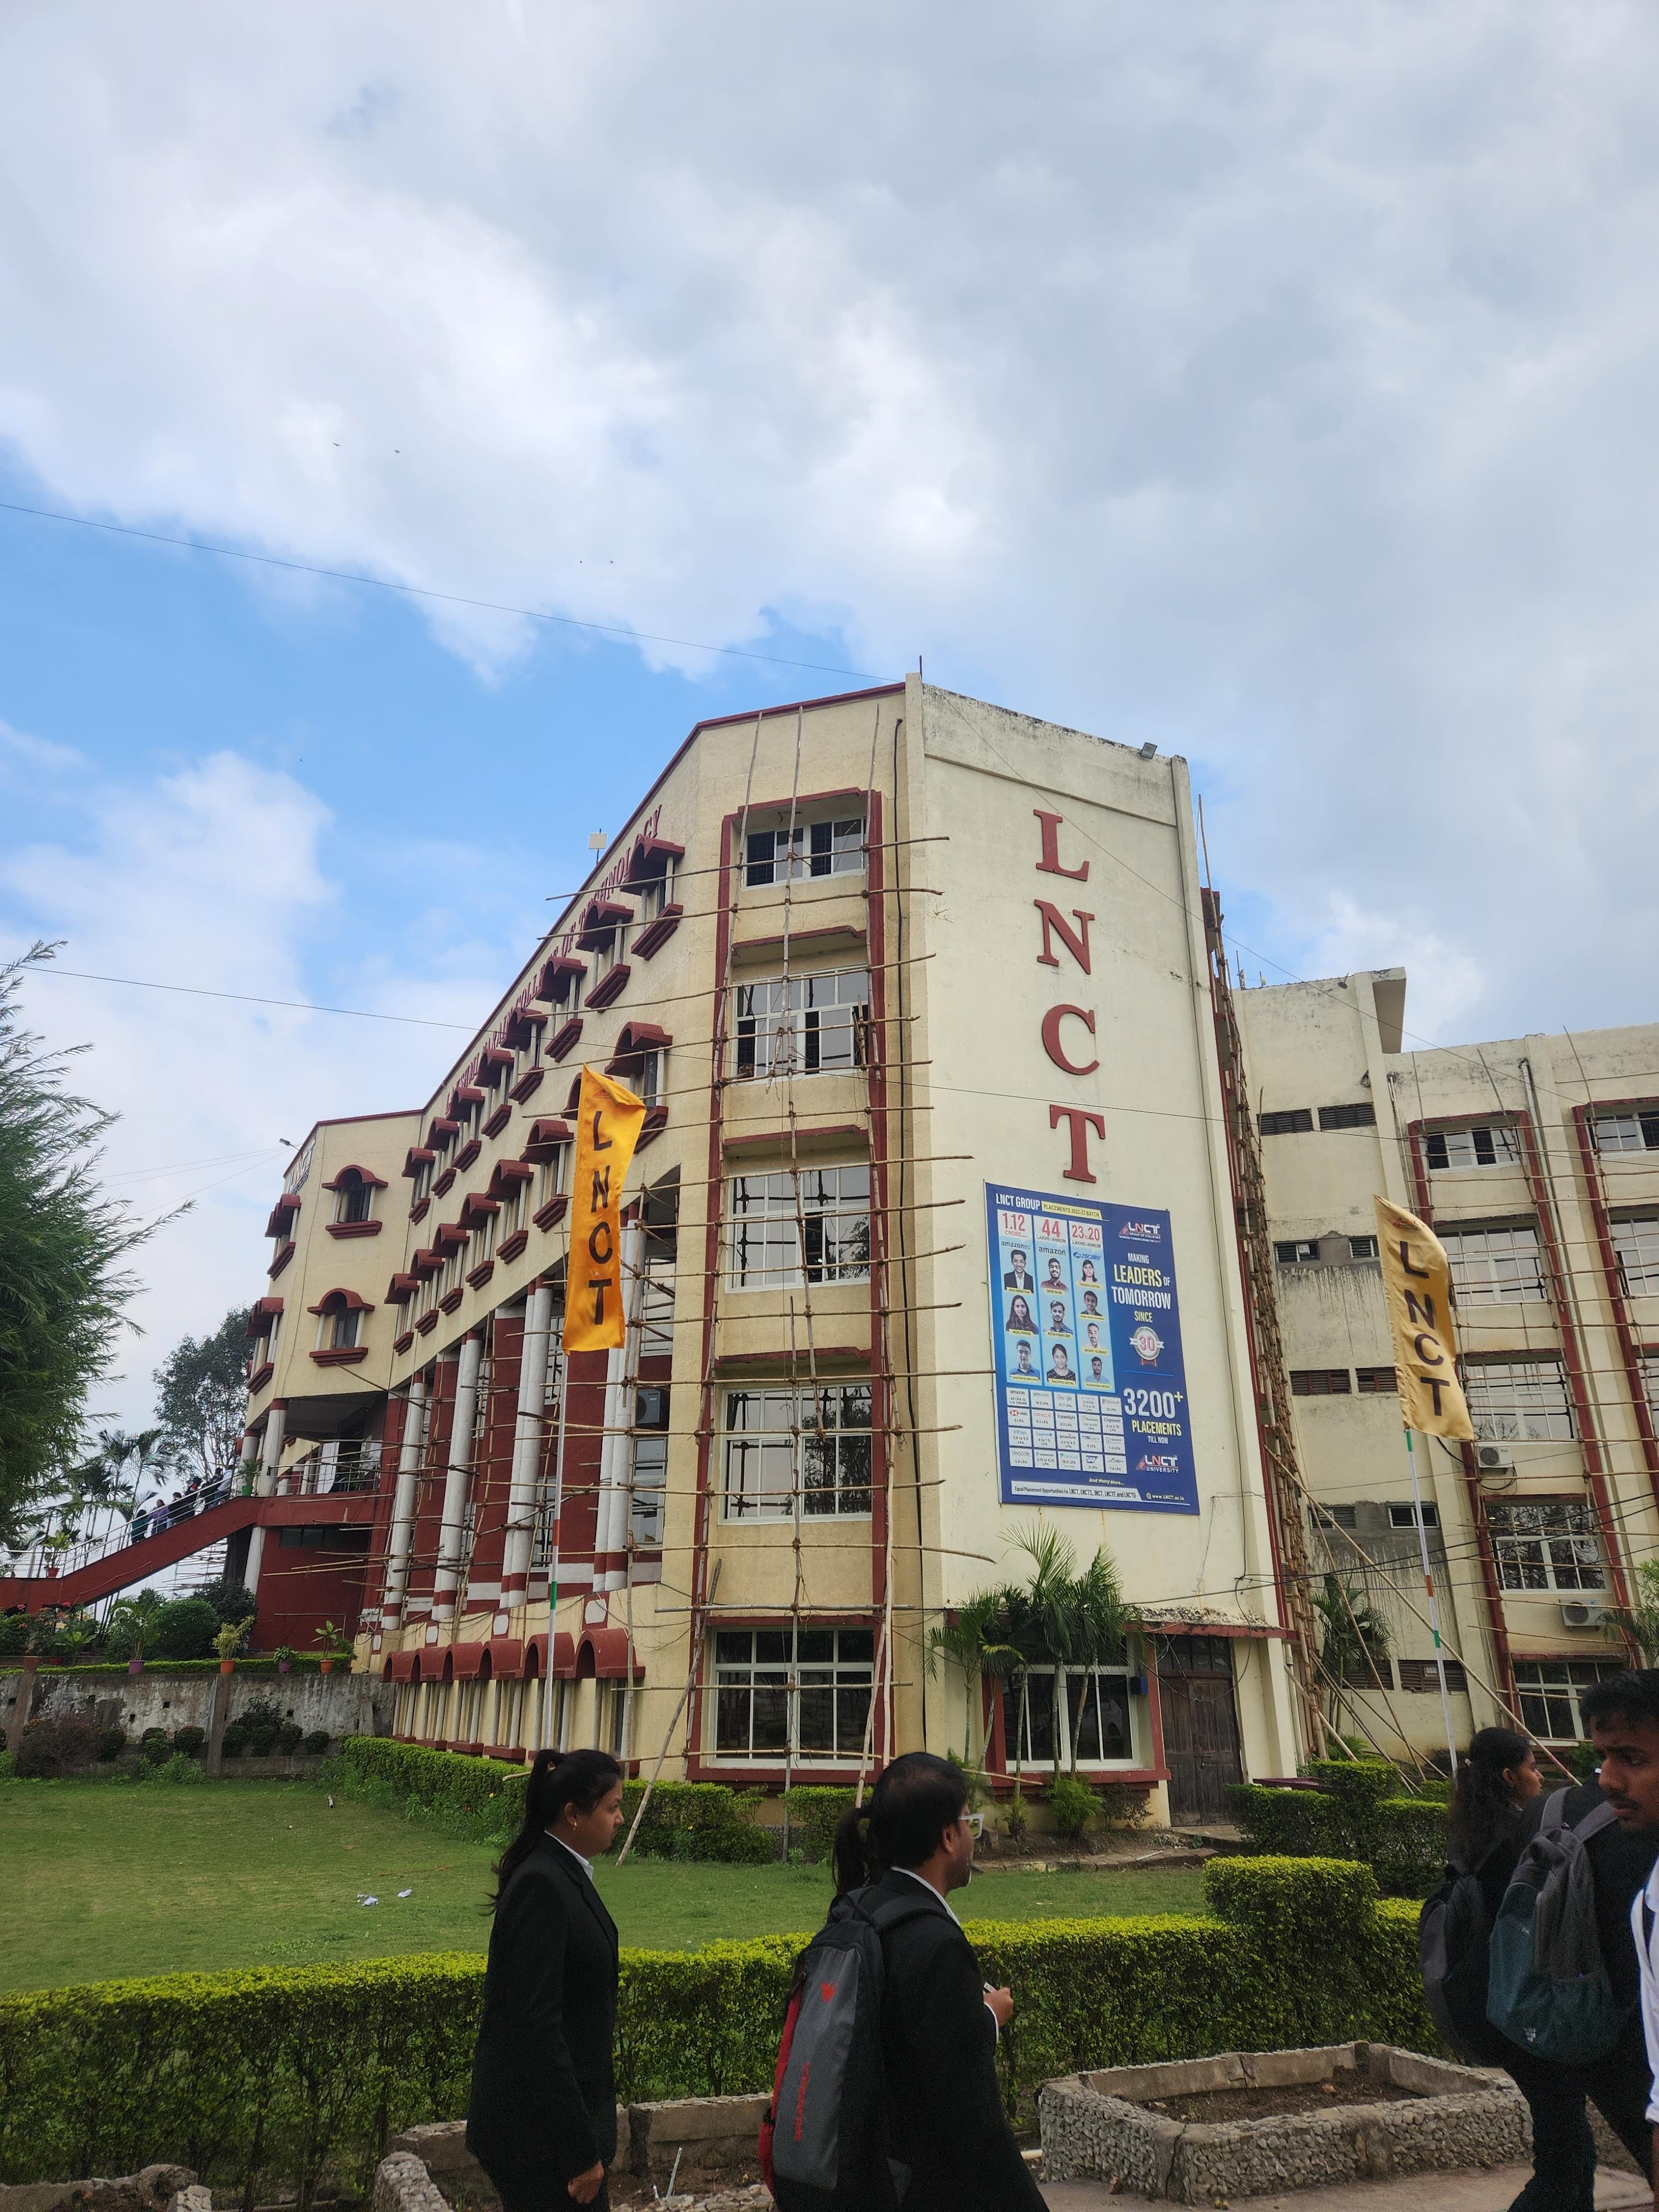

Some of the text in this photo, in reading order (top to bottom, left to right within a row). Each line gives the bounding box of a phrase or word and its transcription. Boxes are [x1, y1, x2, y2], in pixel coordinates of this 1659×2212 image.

[1034, 809, 1106, 1184] LNCT
[996, 1193, 1040, 1211] LNCT GROUP
[1043, 1204, 1071, 1213] PLACEMENTS
[588, 1110, 613, 1326] LNCT
[1003, 1212, 1025, 1232] 1.12
[1042, 1219, 1061, 1238] 44
[1072, 1225, 1084, 1239] 23
[1088, 1227, 1100, 1241] 20
[1128, 1222, 1160, 1234] LNCT
[1039, 1246, 1066, 1256] amazon
[1127, 1253, 1150, 1264] MAKING
[1114, 1264, 1171, 1288] LEADERS OF
[1111, 1286, 1171, 1310] TOMORROW
[1134, 1311, 1154, 1323] SINCE
[1400, 1240, 1450, 1417] LNCT
[1139, 1335, 1155, 1352] 30
[1123, 1388, 1183, 1420] 3200+
[1131, 1420, 1182, 1436] PLACEMENTS
[1158, 1436, 1168, 1444] NOW
[1145, 1454, 1178, 1467] LNCT
